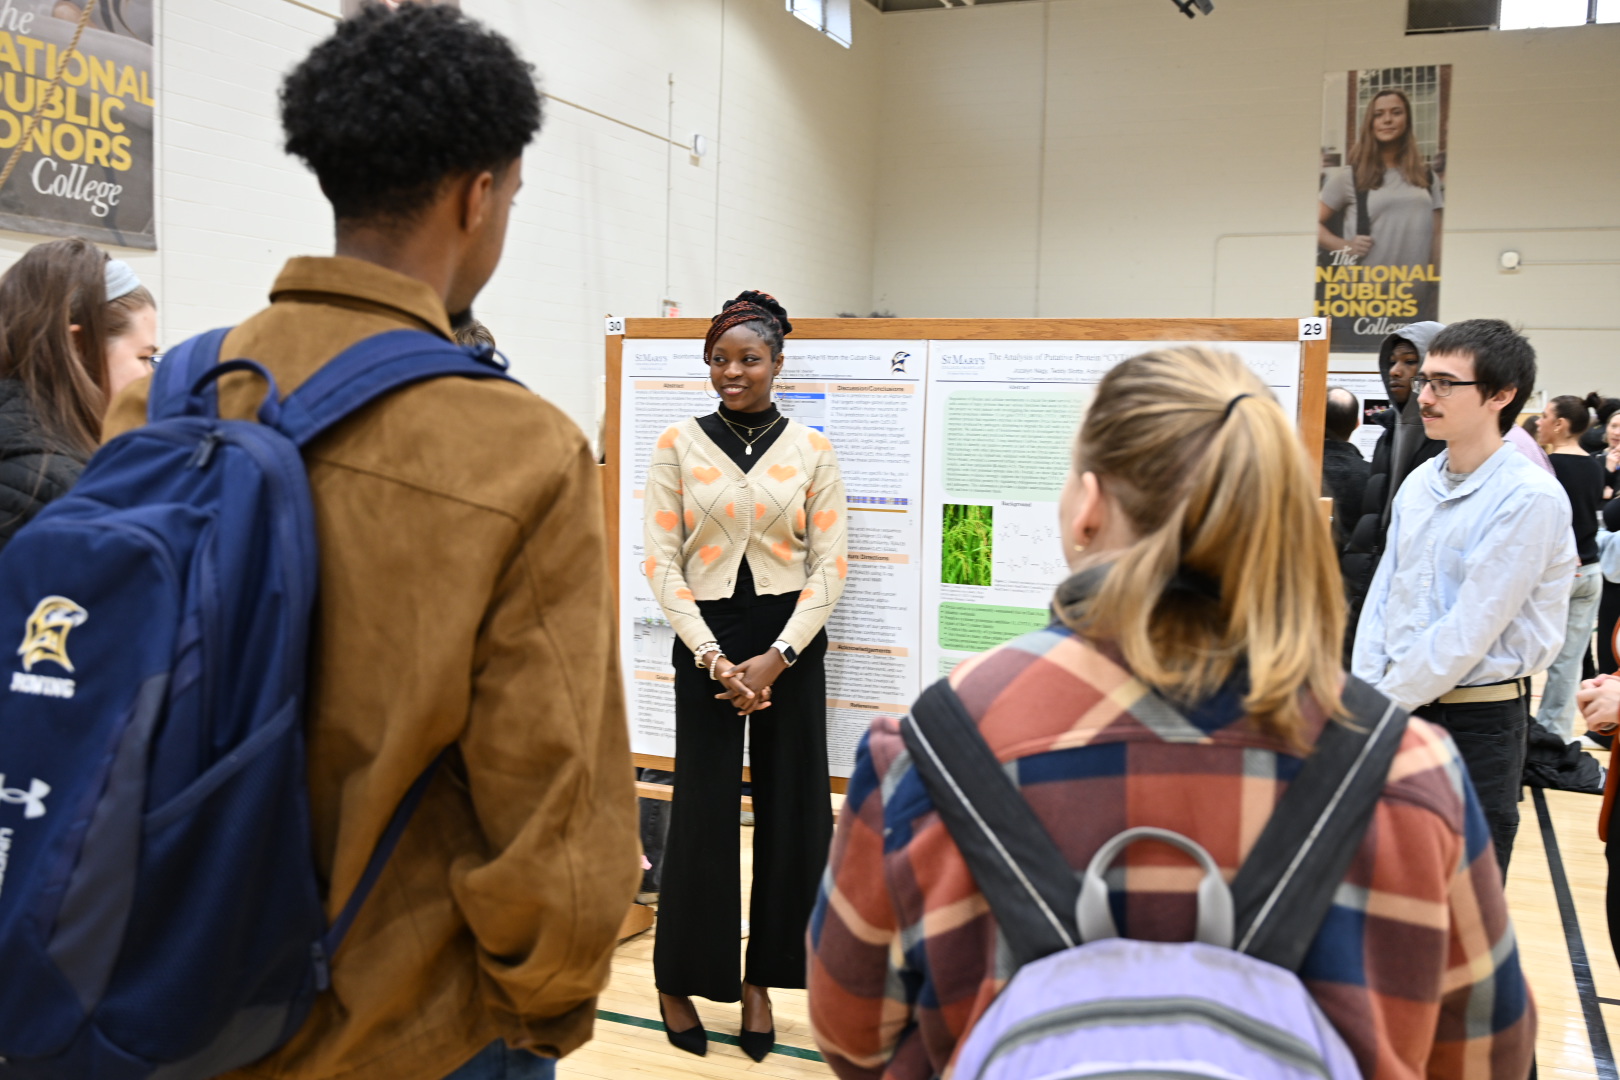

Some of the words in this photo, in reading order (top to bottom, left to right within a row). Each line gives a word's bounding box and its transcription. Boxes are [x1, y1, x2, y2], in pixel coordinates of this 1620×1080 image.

[0, 0, 34, 34] he
[0, 30, 156, 108] ATIONAL
[0, 71, 126, 134] UBLIC
[0, 109, 133, 172] ONORS
[31, 157, 123, 217] College
[1330, 245, 1359, 266] The
[1315, 264, 1442, 283] NATIONAL
[1324, 282, 1414, 300] PUBLIC
[1313, 299, 1418, 317] HONORS
[608, 321, 622, 332] 30
[1303, 323, 1322, 336] 29
